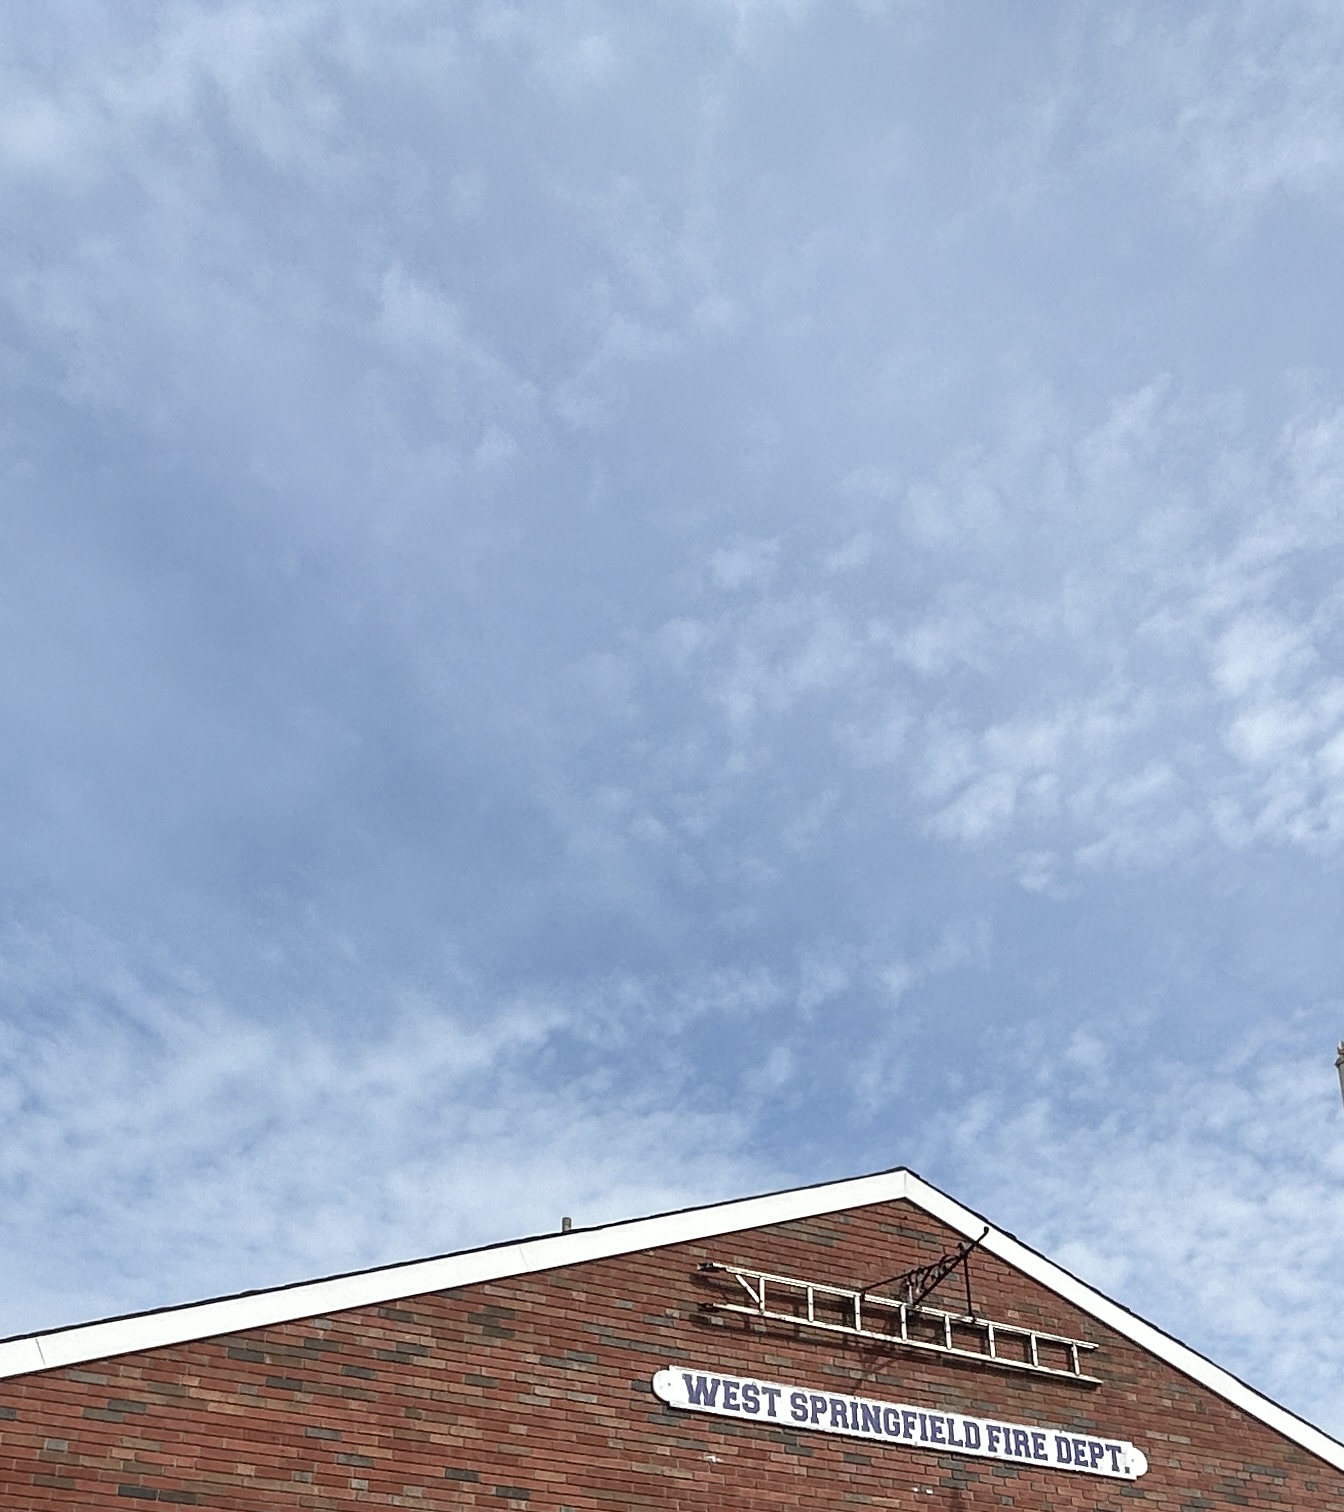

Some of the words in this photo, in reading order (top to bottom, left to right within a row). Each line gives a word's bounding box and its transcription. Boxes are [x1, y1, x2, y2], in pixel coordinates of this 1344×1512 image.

[681, 1373, 782, 1417] WEST
[790, 1392, 981, 1450] SPRINGFIELD
[986, 1427, 1047, 1461] FIRE
[1055, 1436, 1131, 1474] DEPT.
